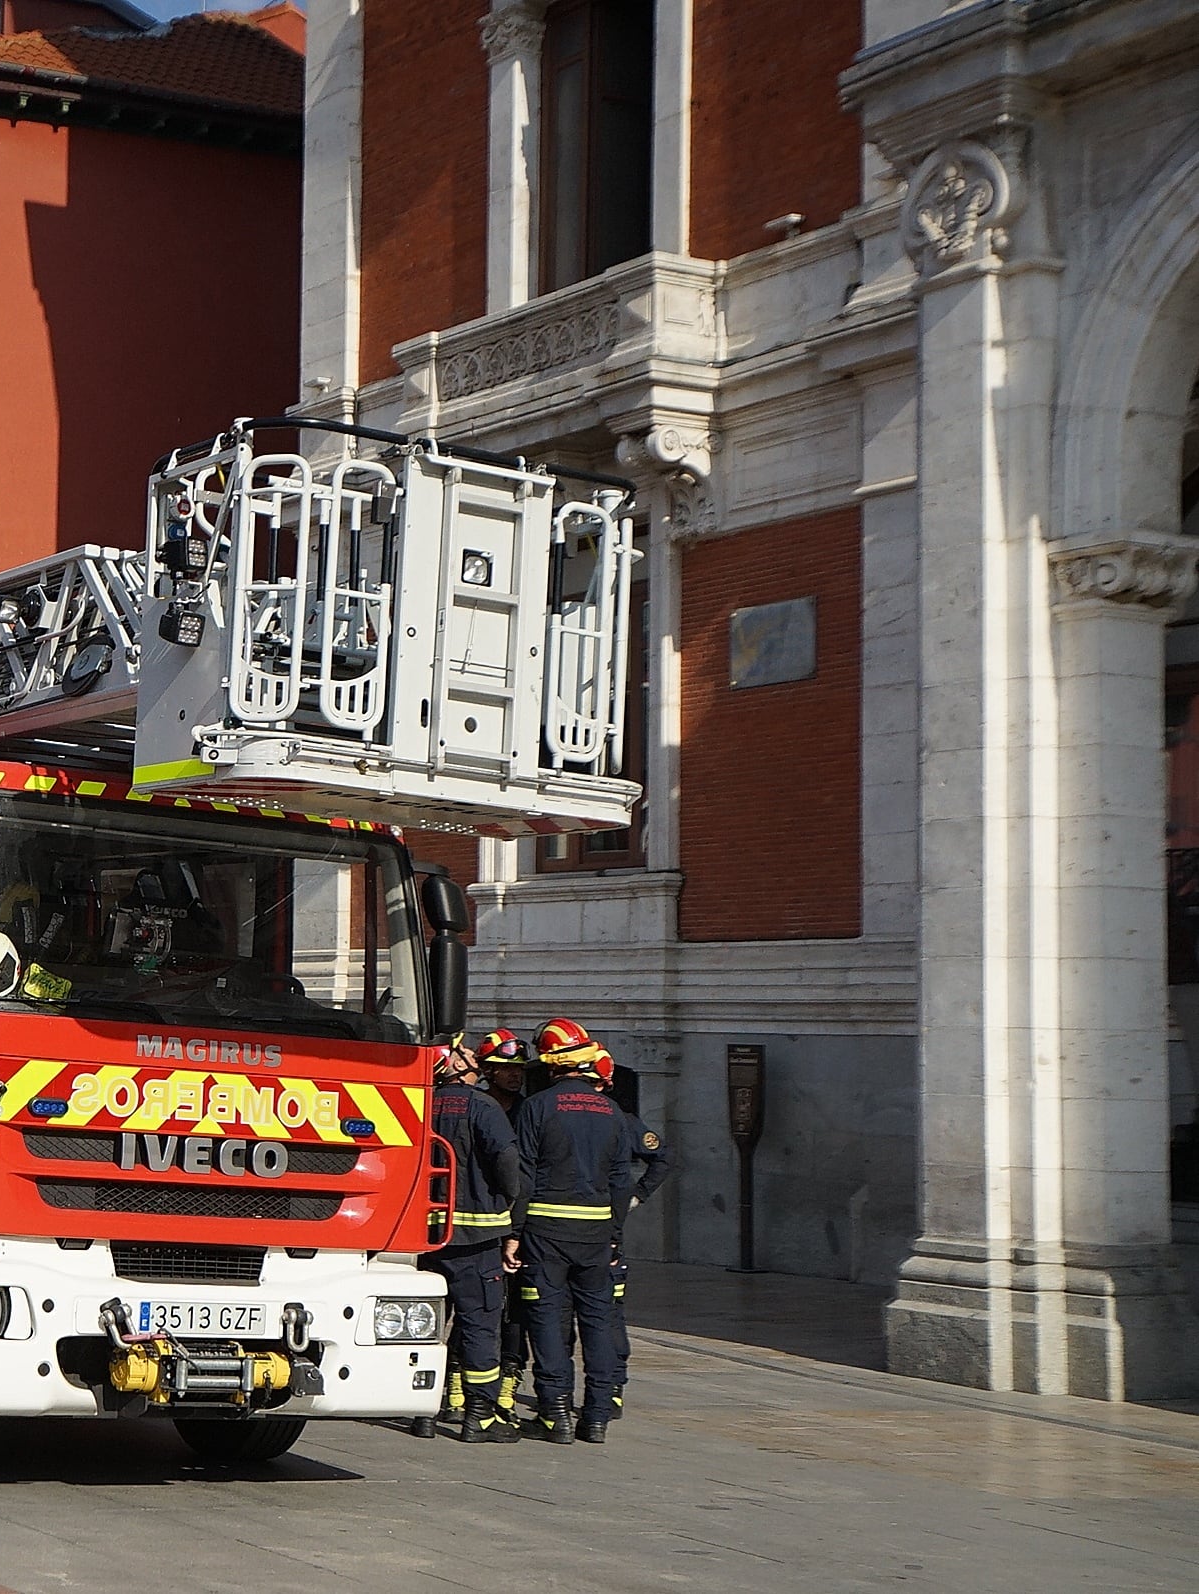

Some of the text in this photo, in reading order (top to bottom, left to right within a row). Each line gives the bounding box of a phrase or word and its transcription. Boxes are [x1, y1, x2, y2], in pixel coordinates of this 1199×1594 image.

[136, 1034, 284, 1069] MAGIRUS
[119, 1132, 289, 1179] IVECO
[154, 1305, 212, 1330] 3513
[219, 1307, 262, 1331] GZF
